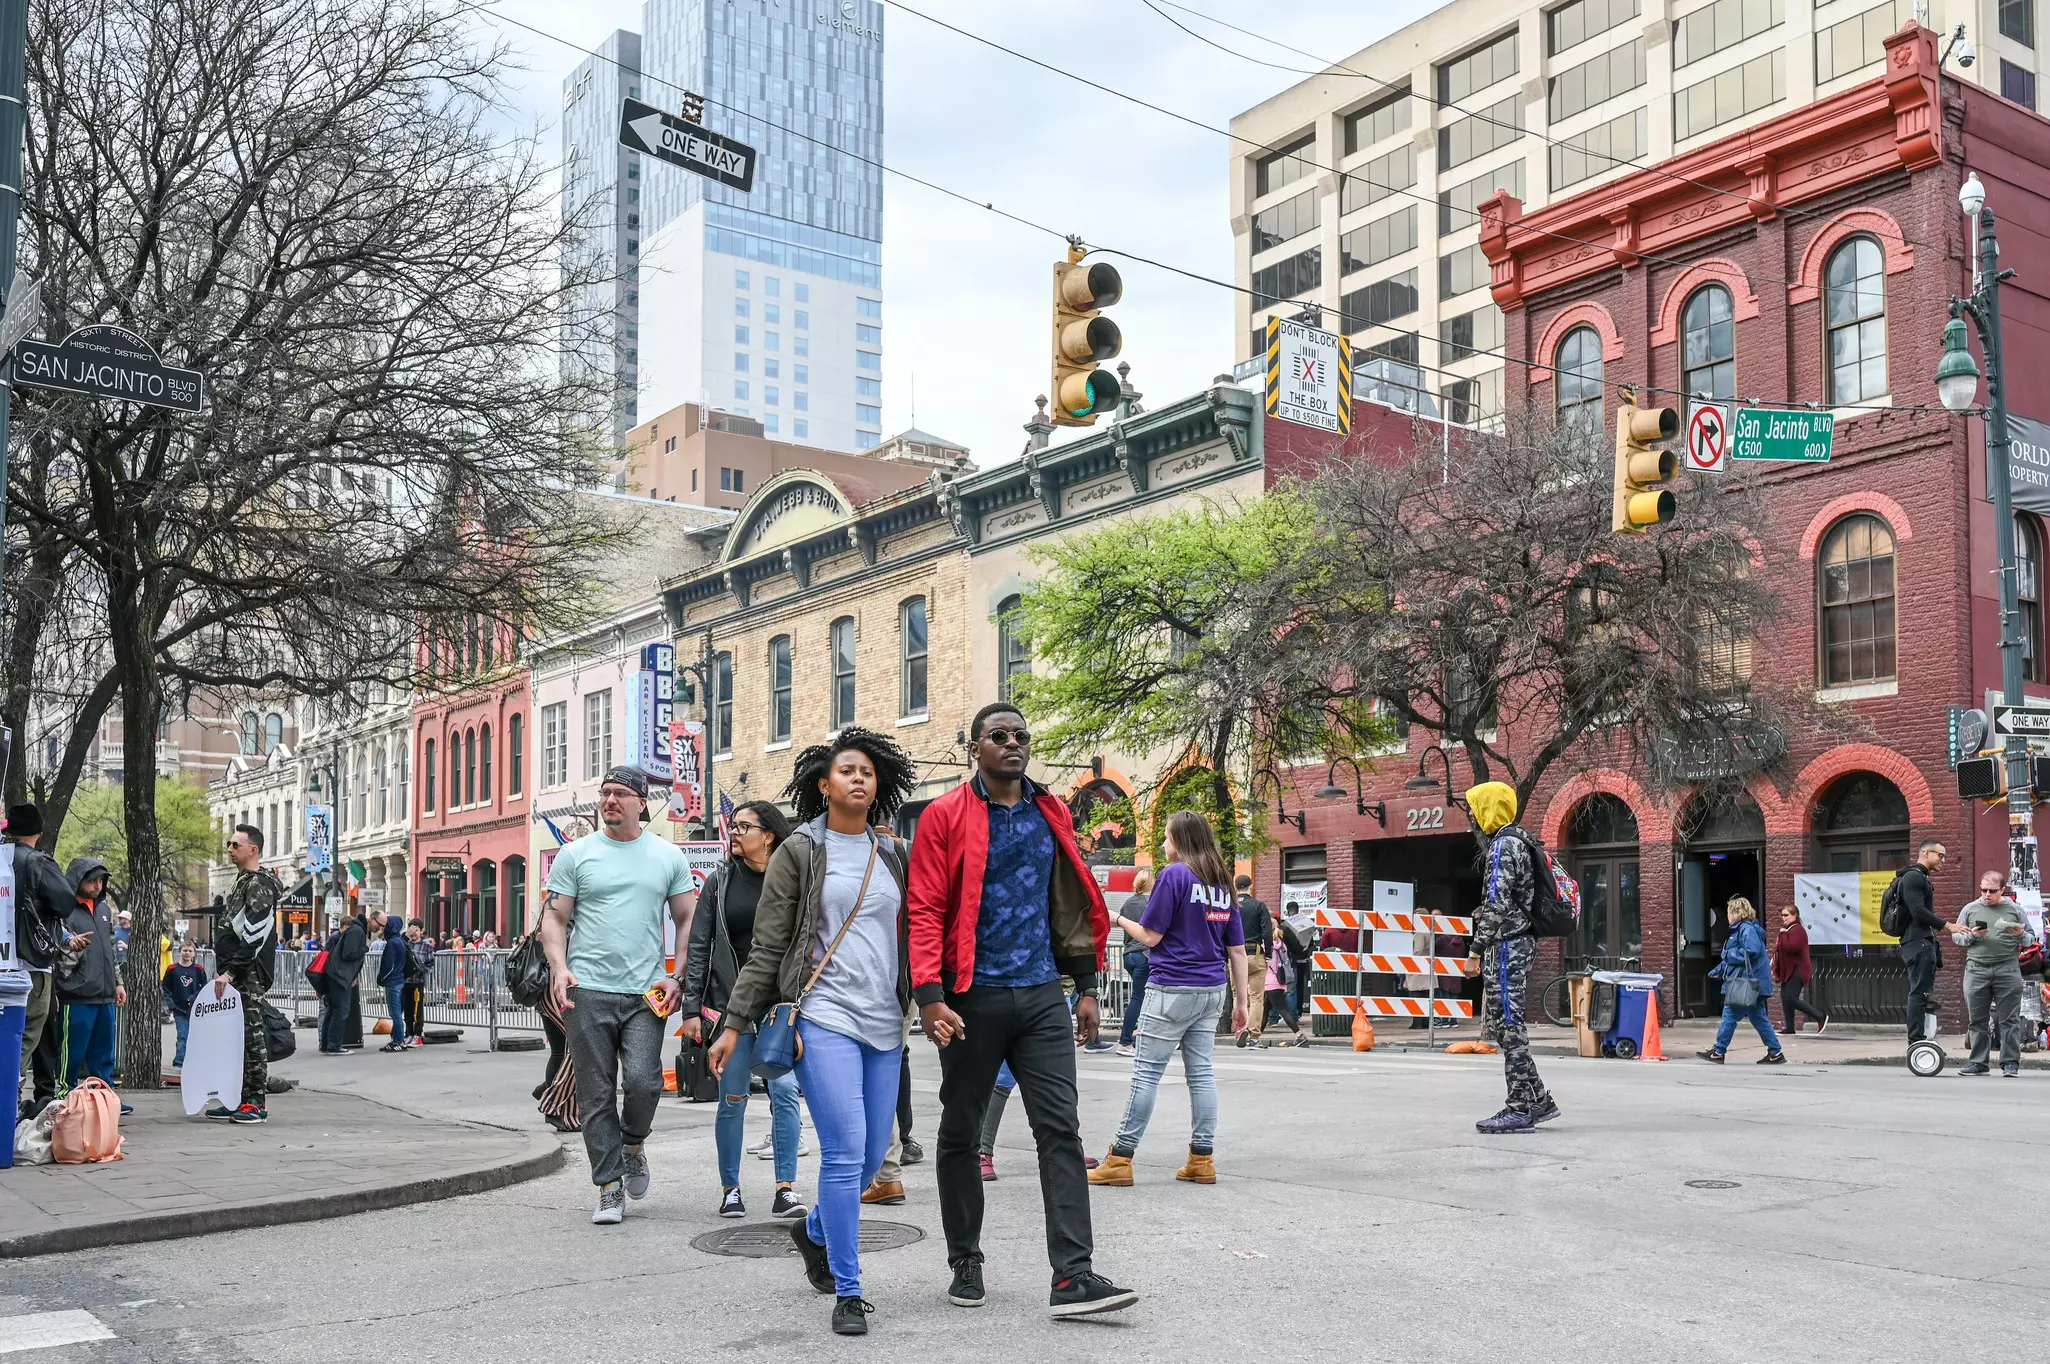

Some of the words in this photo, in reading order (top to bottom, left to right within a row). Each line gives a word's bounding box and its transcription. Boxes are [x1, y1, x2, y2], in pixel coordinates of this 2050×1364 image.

[817, 13, 881, 41] element
[661, 128, 698, 158] ONE
[704, 143, 741, 173] WAY
[110, 328, 145, 349] STREET
[1308, 330, 1338, 350] BLOCK
[69, 340, 111, 354] HISTORIC
[114, 348, 153, 361] DISTRICT
[22, 351, 69, 380] SAN
[73, 361, 164, 397] JACINTO
[168, 378, 197, 392] BLVD
[171, 391, 193, 403] 500
[1290, 391, 1306, 406] THE
[1310, 396, 1328, 412] BOX
[1280, 406, 1290, 417] UP
[1292, 408, 1301, 420] TO
[1303, 412, 1320, 424] $500
[1321, 416, 1336, 429] FINE
[1737, 413, 1760, 438] San
[1765, 415, 1809, 440] Jacinto
[1813, 416, 1831, 433] BLVD
[1744, 441, 1762, 456] 500
[1804, 443, 1820, 457] 600
[2008, 436, 2050, 467] ORLD
[774, 489, 803, 515] WEBB
[805, 488, 814, 503] &
[2012, 715, 2029, 727] ONE
[2032, 716, 2049, 728] WAY
[673, 739, 692, 755] SX
[649, 762, 673, 775] SPOR
[674, 754, 697, 770] SW
[1406, 806, 1444, 831] 222
[689, 861, 715, 869] OOTERS
[0, 886, 9, 897] ON
[194, 996, 237, 1018] @jcreek813
